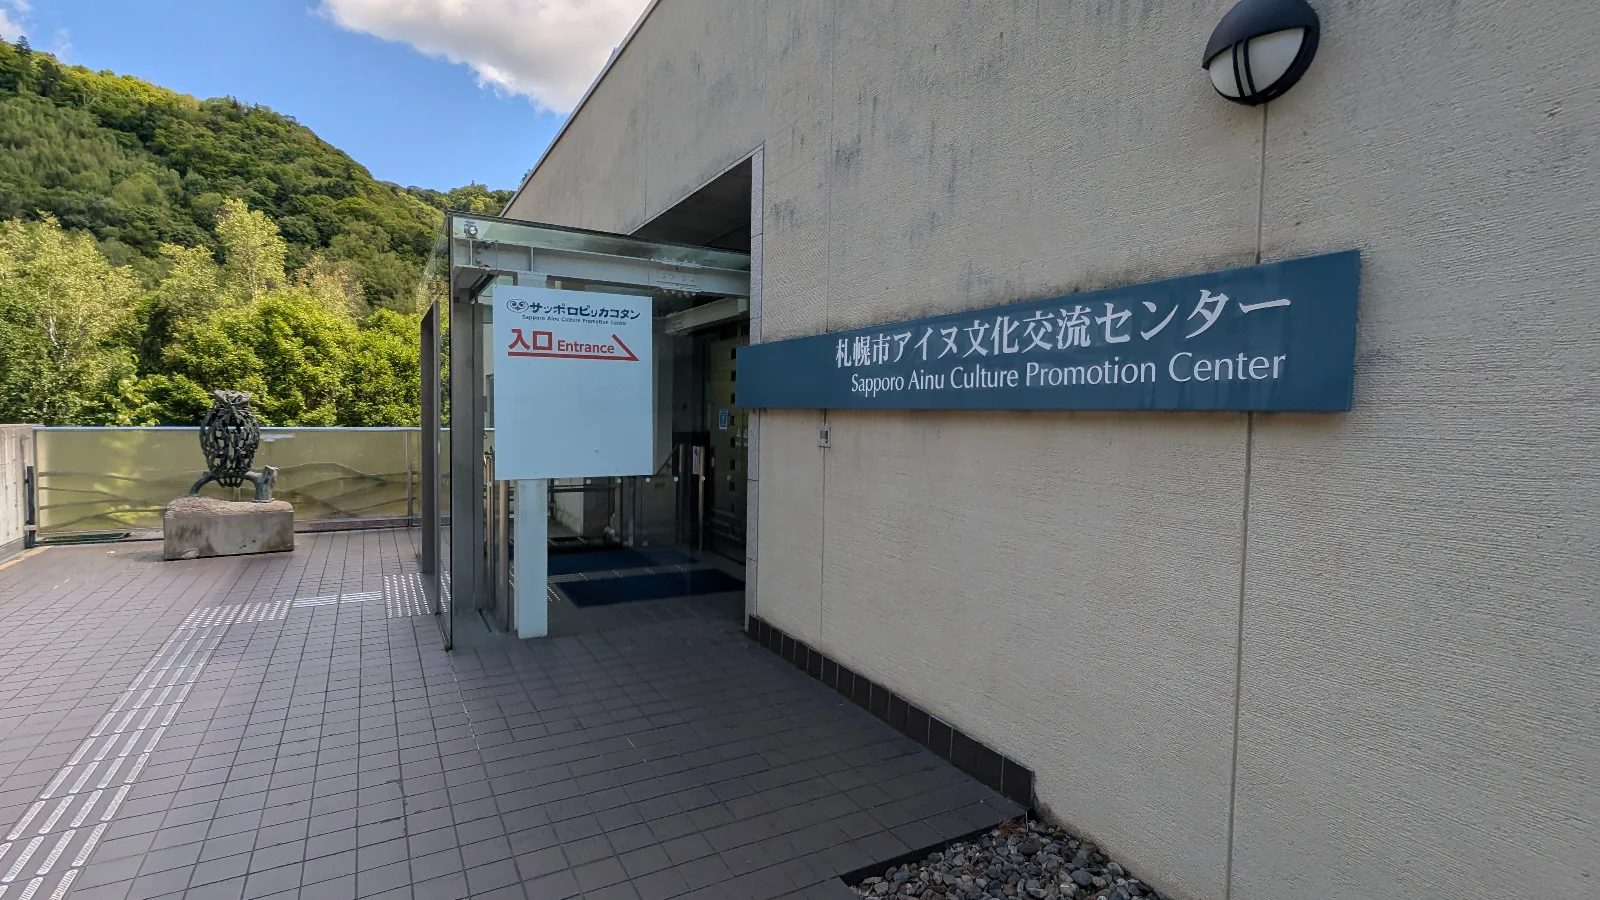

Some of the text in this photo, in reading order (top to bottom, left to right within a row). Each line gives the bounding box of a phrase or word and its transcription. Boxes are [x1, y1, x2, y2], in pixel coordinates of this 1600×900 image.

[508, 328, 615, 354] 入口 Entrance
[835, 289, 1292, 369] 札幌市アイヌ文化交流センター
[851, 351, 1287, 397] Sapporo Ainu Culture Promotion Center
